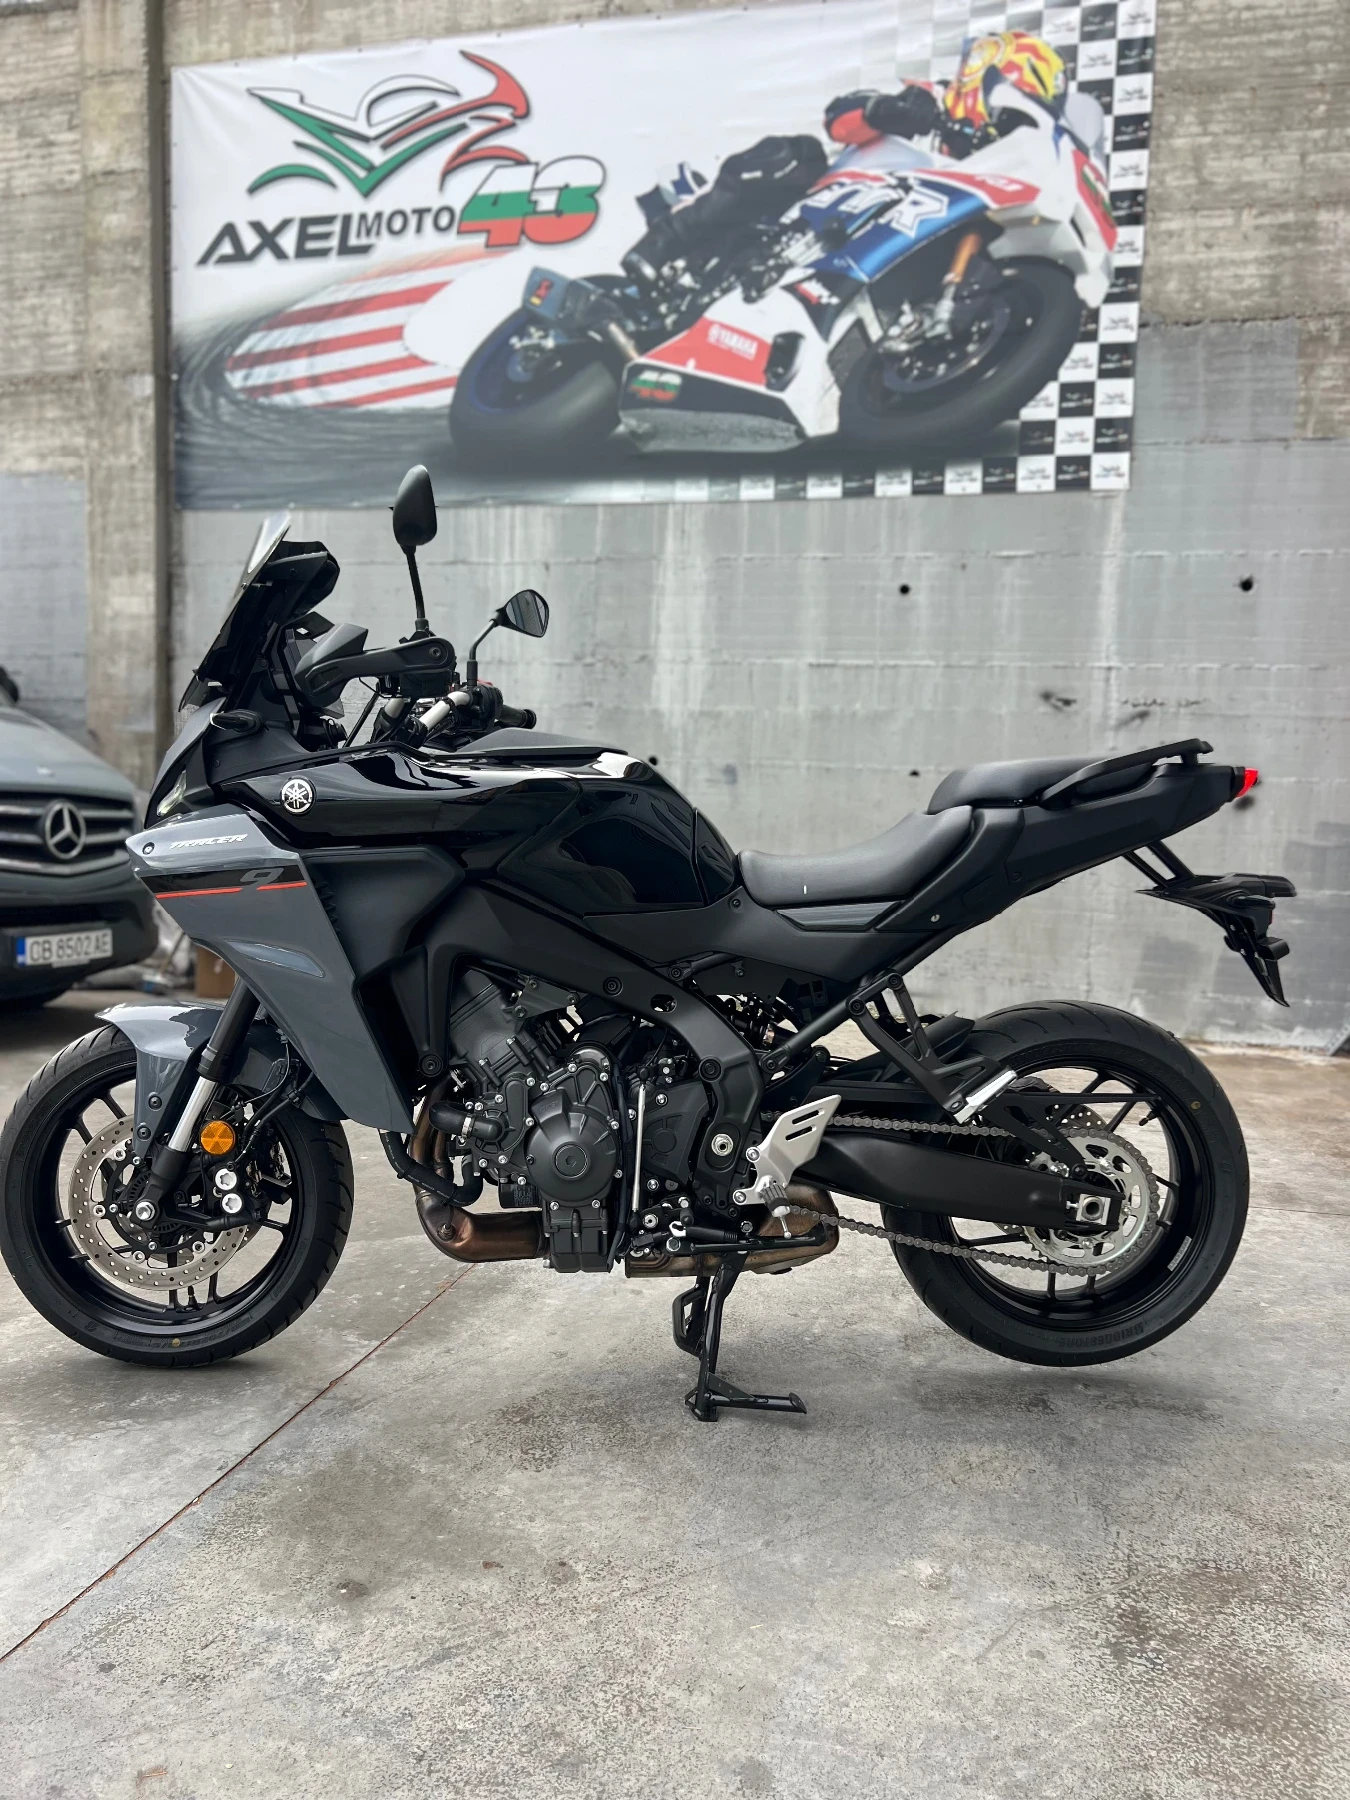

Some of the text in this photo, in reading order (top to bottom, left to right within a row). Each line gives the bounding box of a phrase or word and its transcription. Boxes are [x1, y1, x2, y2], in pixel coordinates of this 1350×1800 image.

[196, 155, 607, 267] AXEL MOTO 43
[169, 834, 249, 850] TRACER
[239, 867, 285, 890] 9
